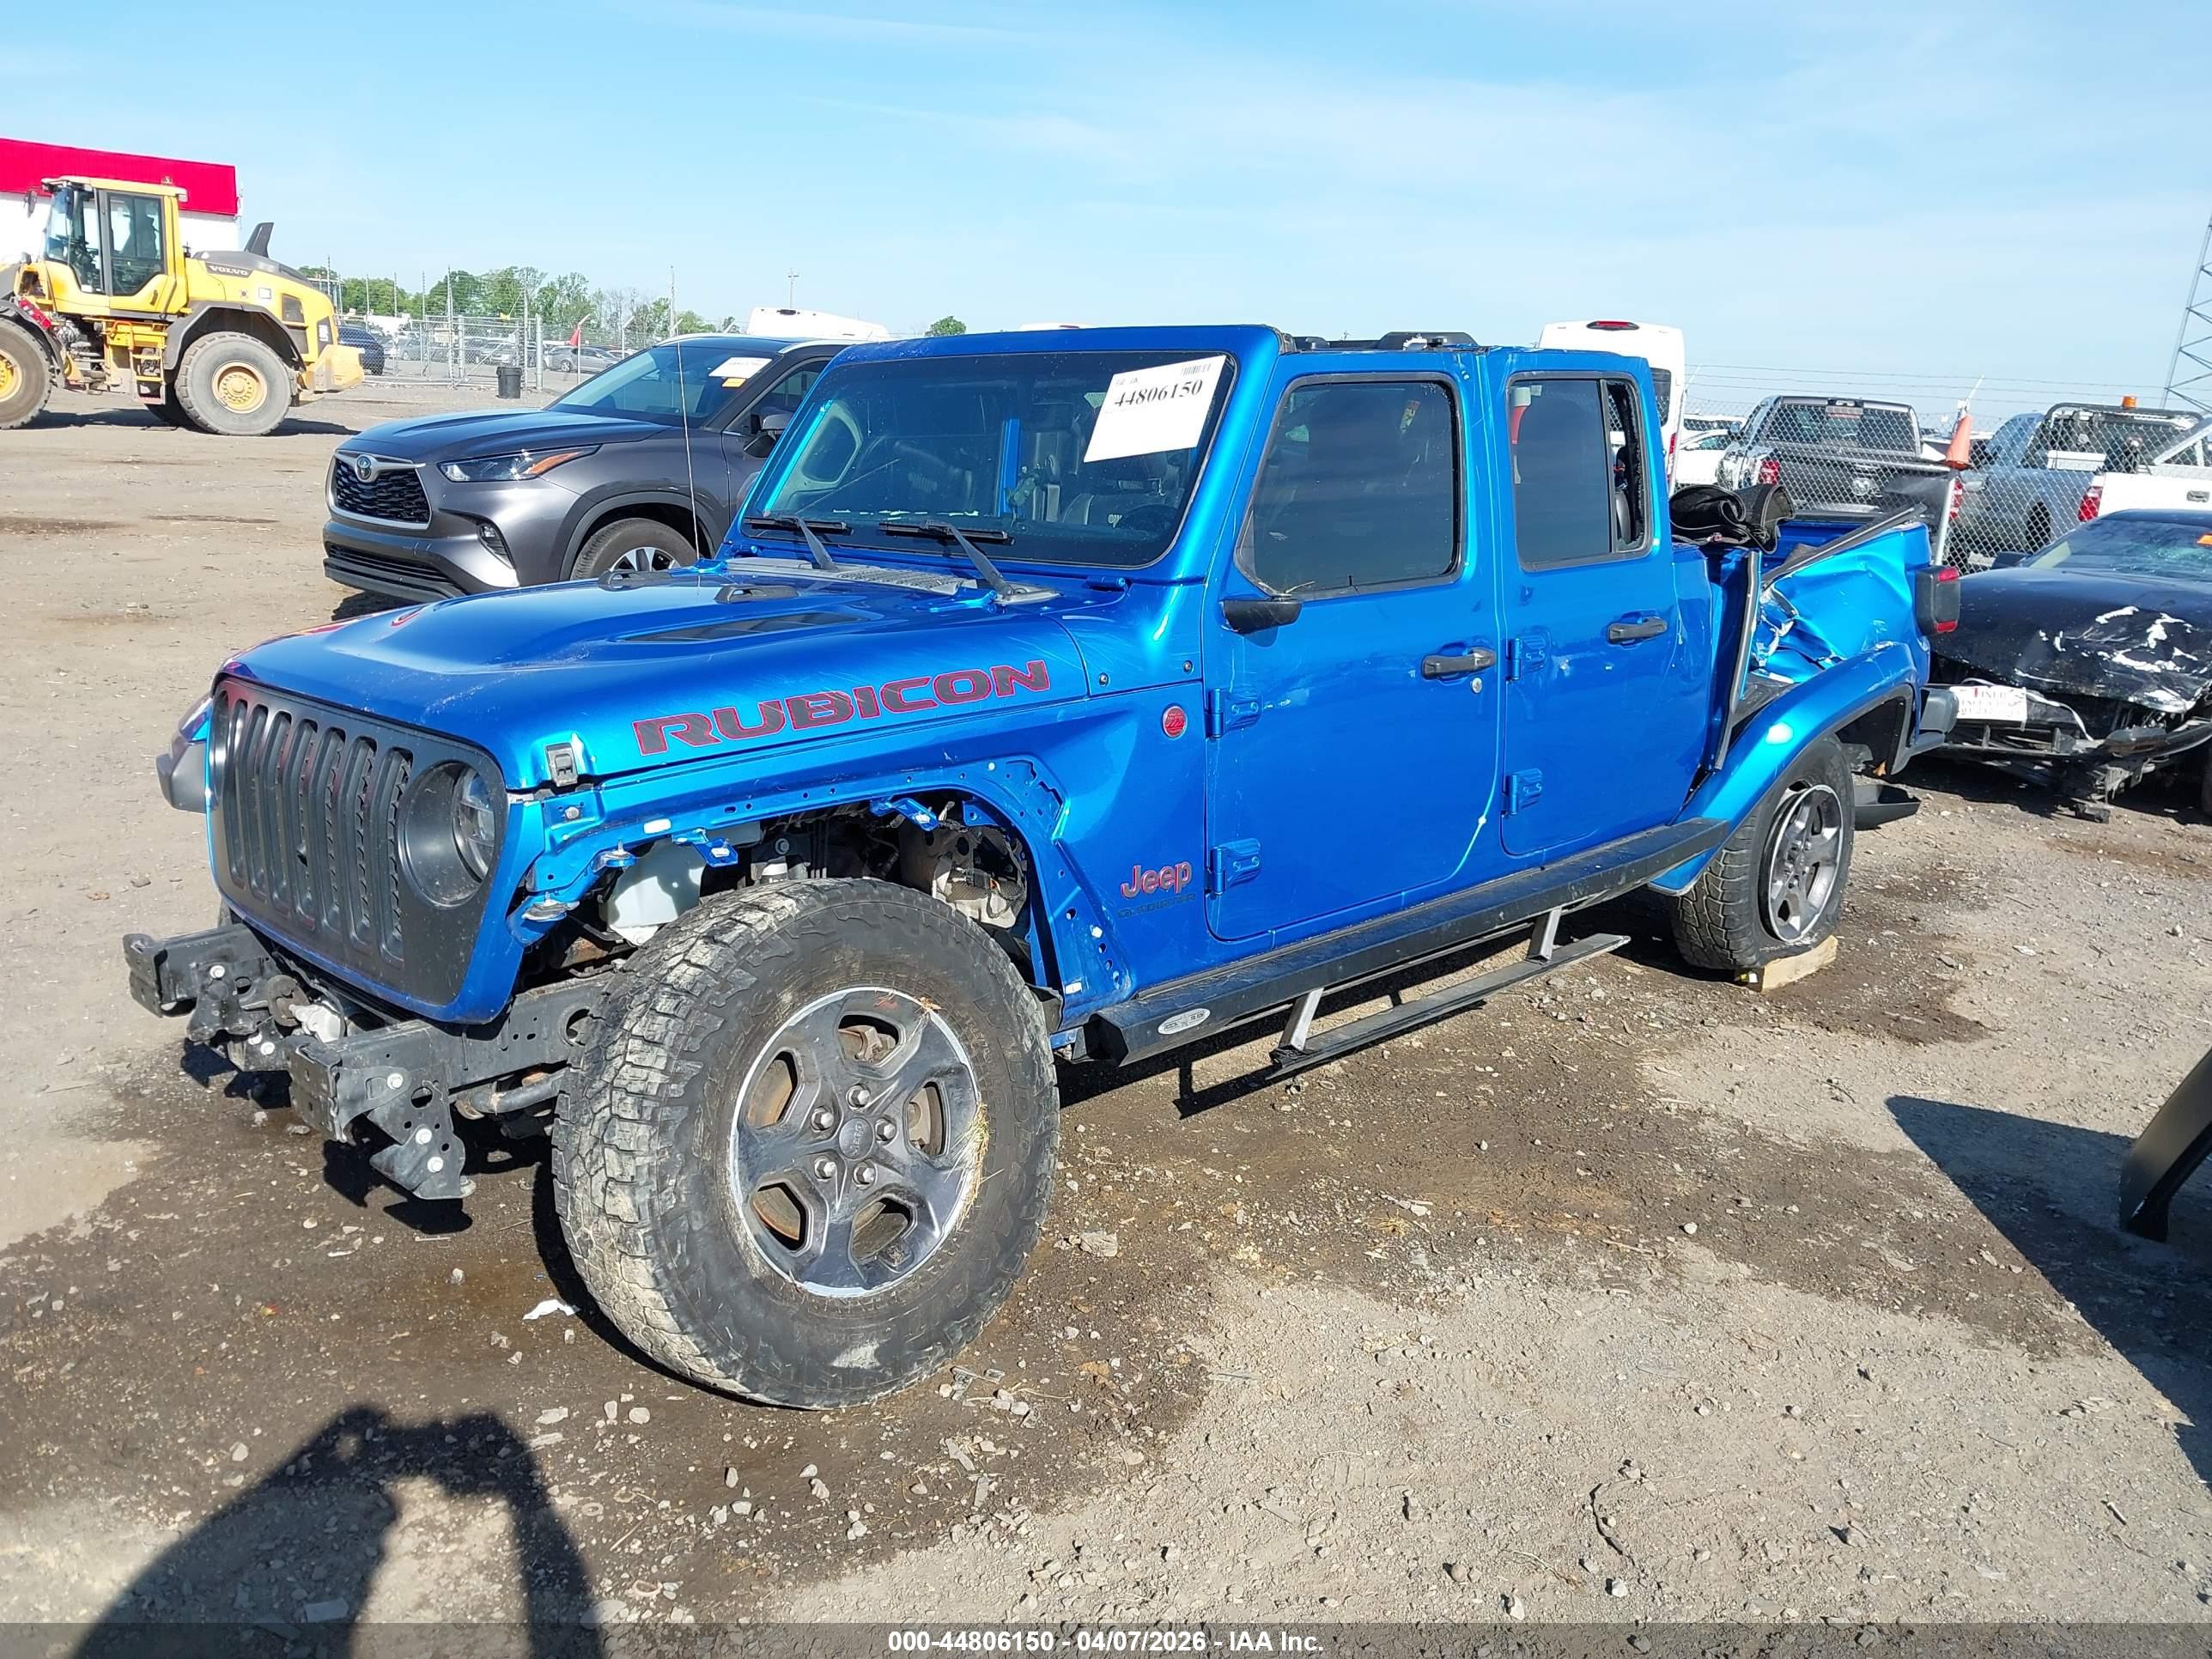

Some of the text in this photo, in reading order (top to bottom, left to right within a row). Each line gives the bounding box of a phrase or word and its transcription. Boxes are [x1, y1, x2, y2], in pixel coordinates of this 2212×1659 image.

[209, 264, 249, 276] VOLVO
[1114, 379, 1204, 408] 44806150
[632, 659, 1051, 757] RUBICON
[1121, 861, 1192, 899] Jeep
